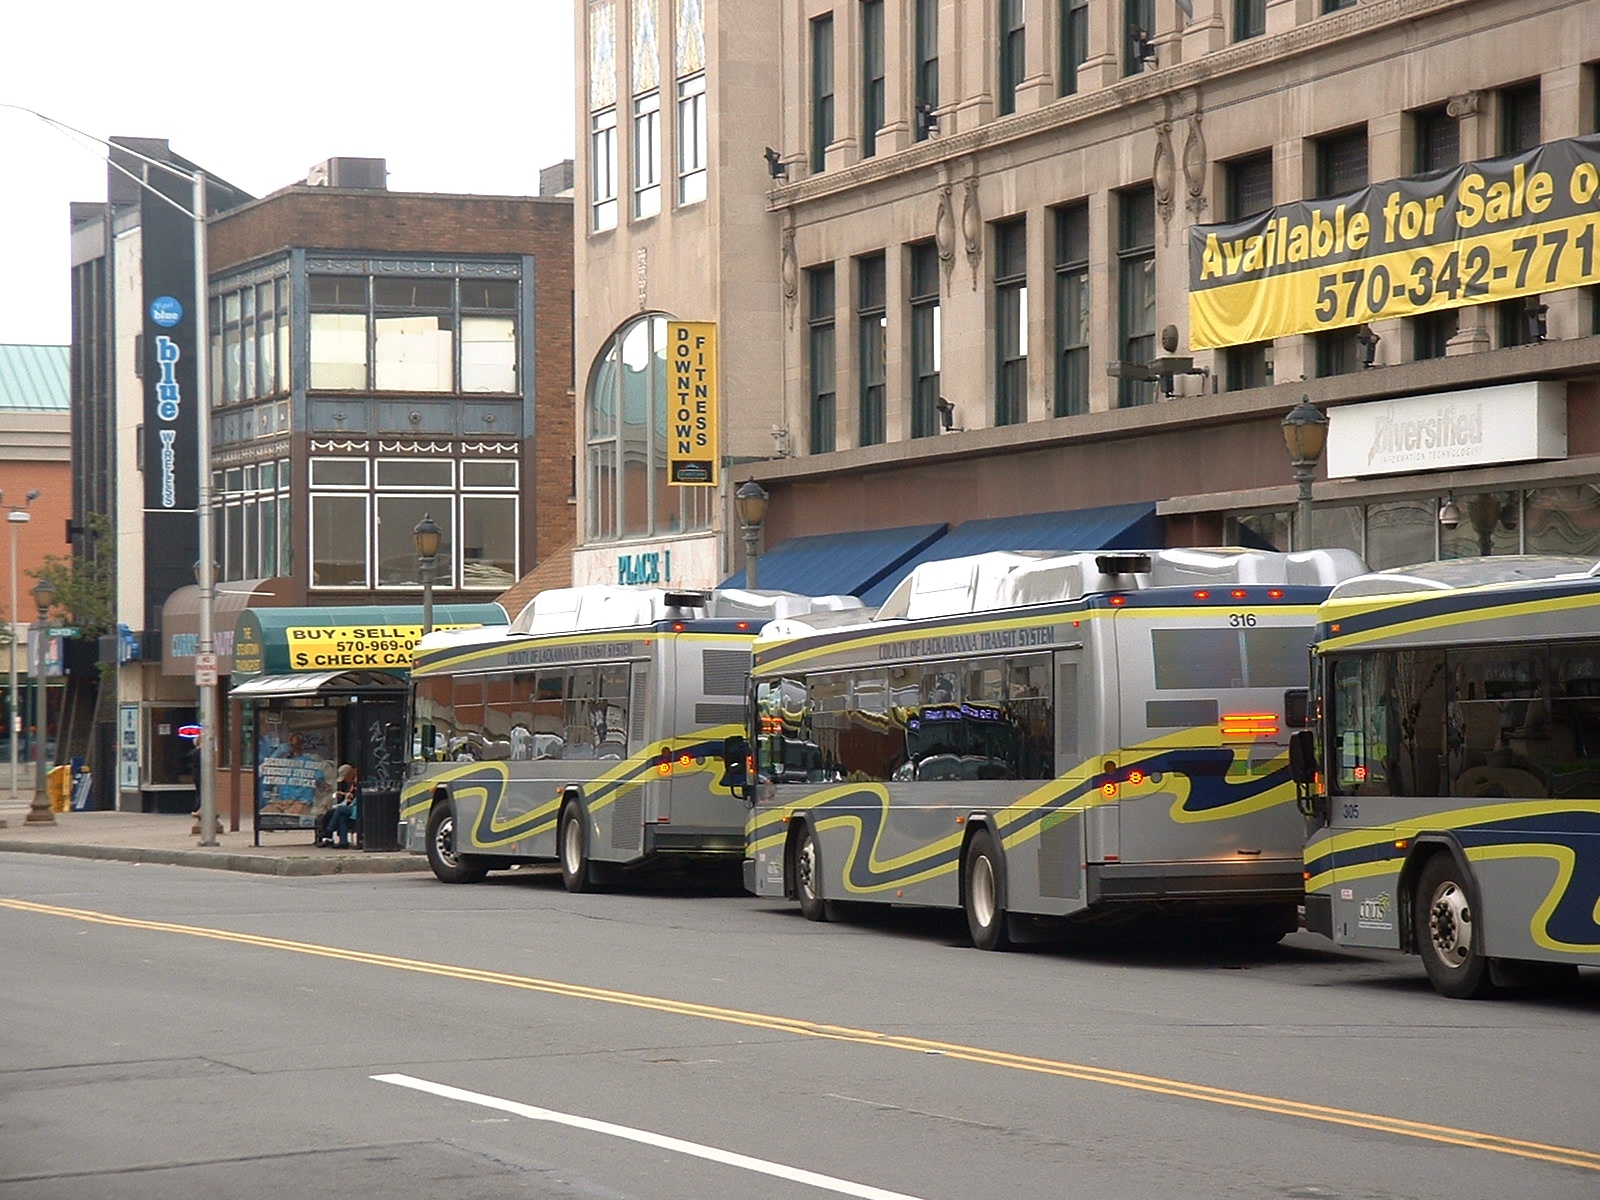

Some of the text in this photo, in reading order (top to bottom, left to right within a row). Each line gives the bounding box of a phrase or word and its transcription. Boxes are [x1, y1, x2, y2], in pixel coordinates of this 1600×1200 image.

[1200, 162, 1600, 281] Available for Sale o
[156, 335, 180, 421] blue
[675, 328, 691, 454] DOWNTOWN
[695, 336, 708, 446] FITNESS
[159, 430, 176, 507] WIRELESS
[618, 553, 660, 585] PLACE
[293, 628, 405, 639] BUY SELL
[1229, 613, 1257, 628] 316
[315, 653, 377, 665] CHECK
[879, 626, 1055, 659] COUNTY OF LACKAWANNA TRANSIT SYSTEM
[1343, 804, 1360, 819] 305
